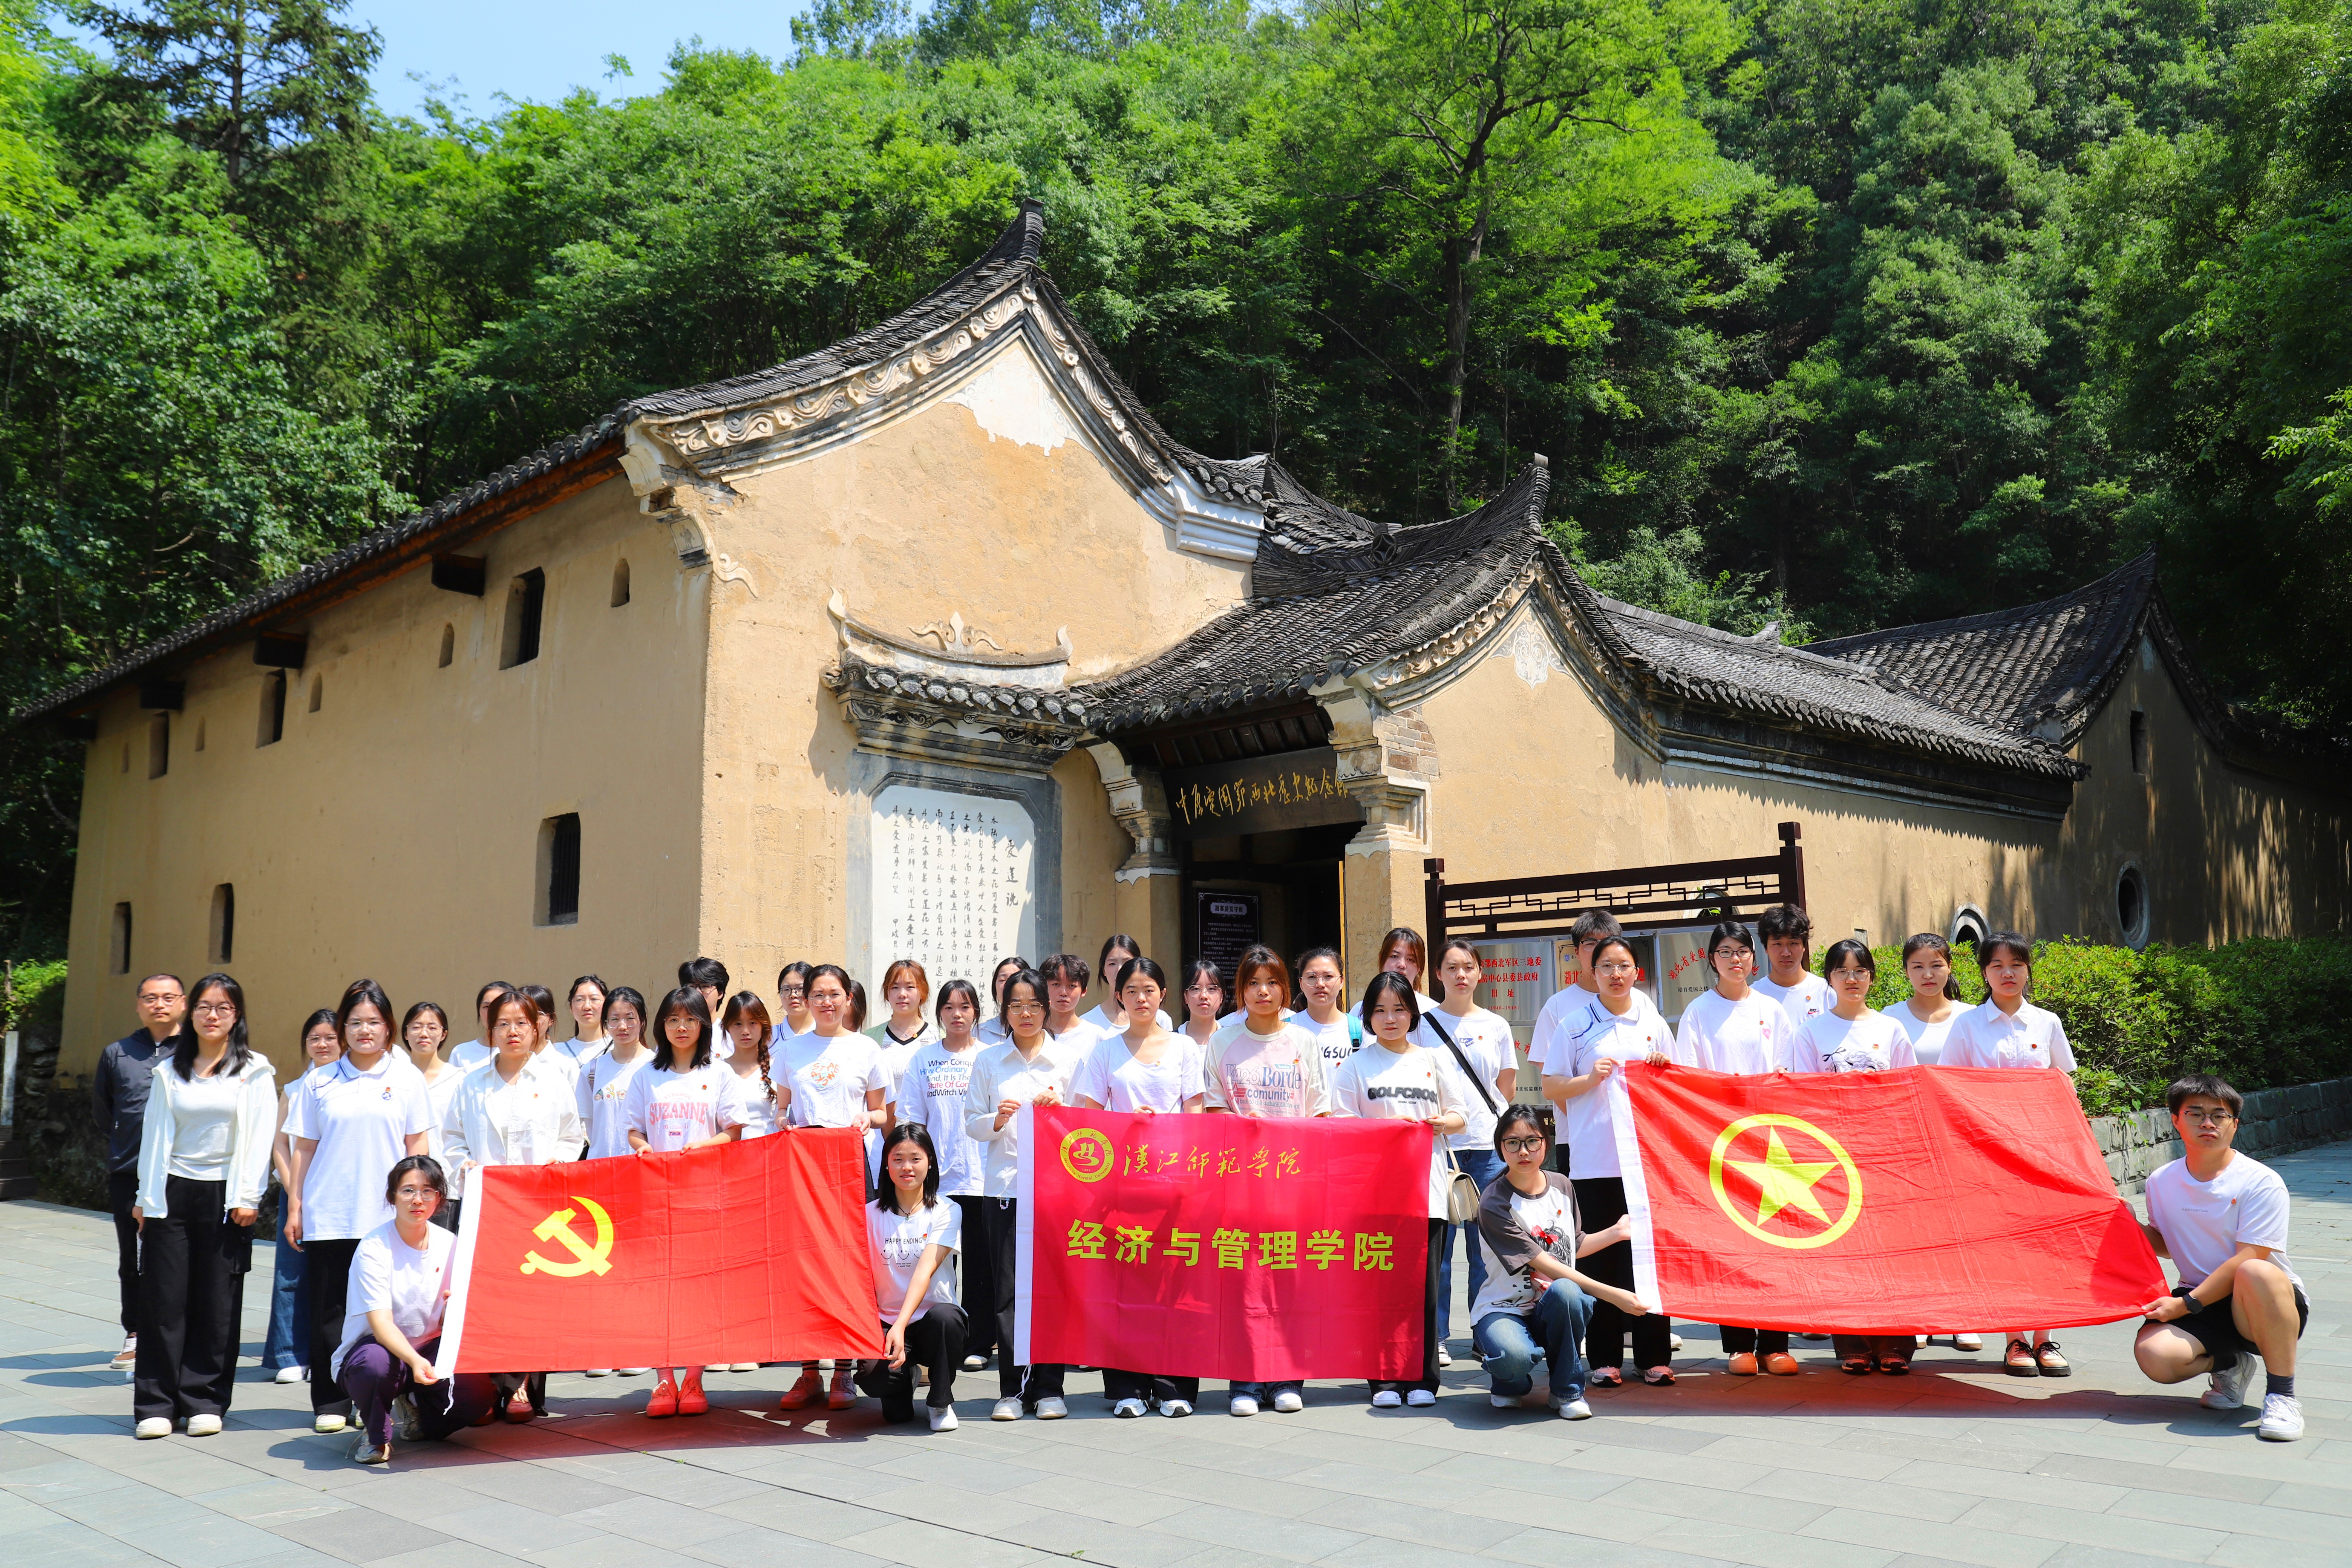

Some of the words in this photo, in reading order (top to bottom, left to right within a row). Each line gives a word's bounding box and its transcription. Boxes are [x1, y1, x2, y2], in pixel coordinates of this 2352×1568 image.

[1321, 1046, 1351, 1059] GSU
[935, 1066, 968, 1074] Ordinary
[1247, 1089, 1291, 1102] comunity
[649, 1102, 709, 1125] SUZANNE
[1094, 1162, 1111, 1179] University
[1066, 1218, 1394, 1271] 经济与管理学院
